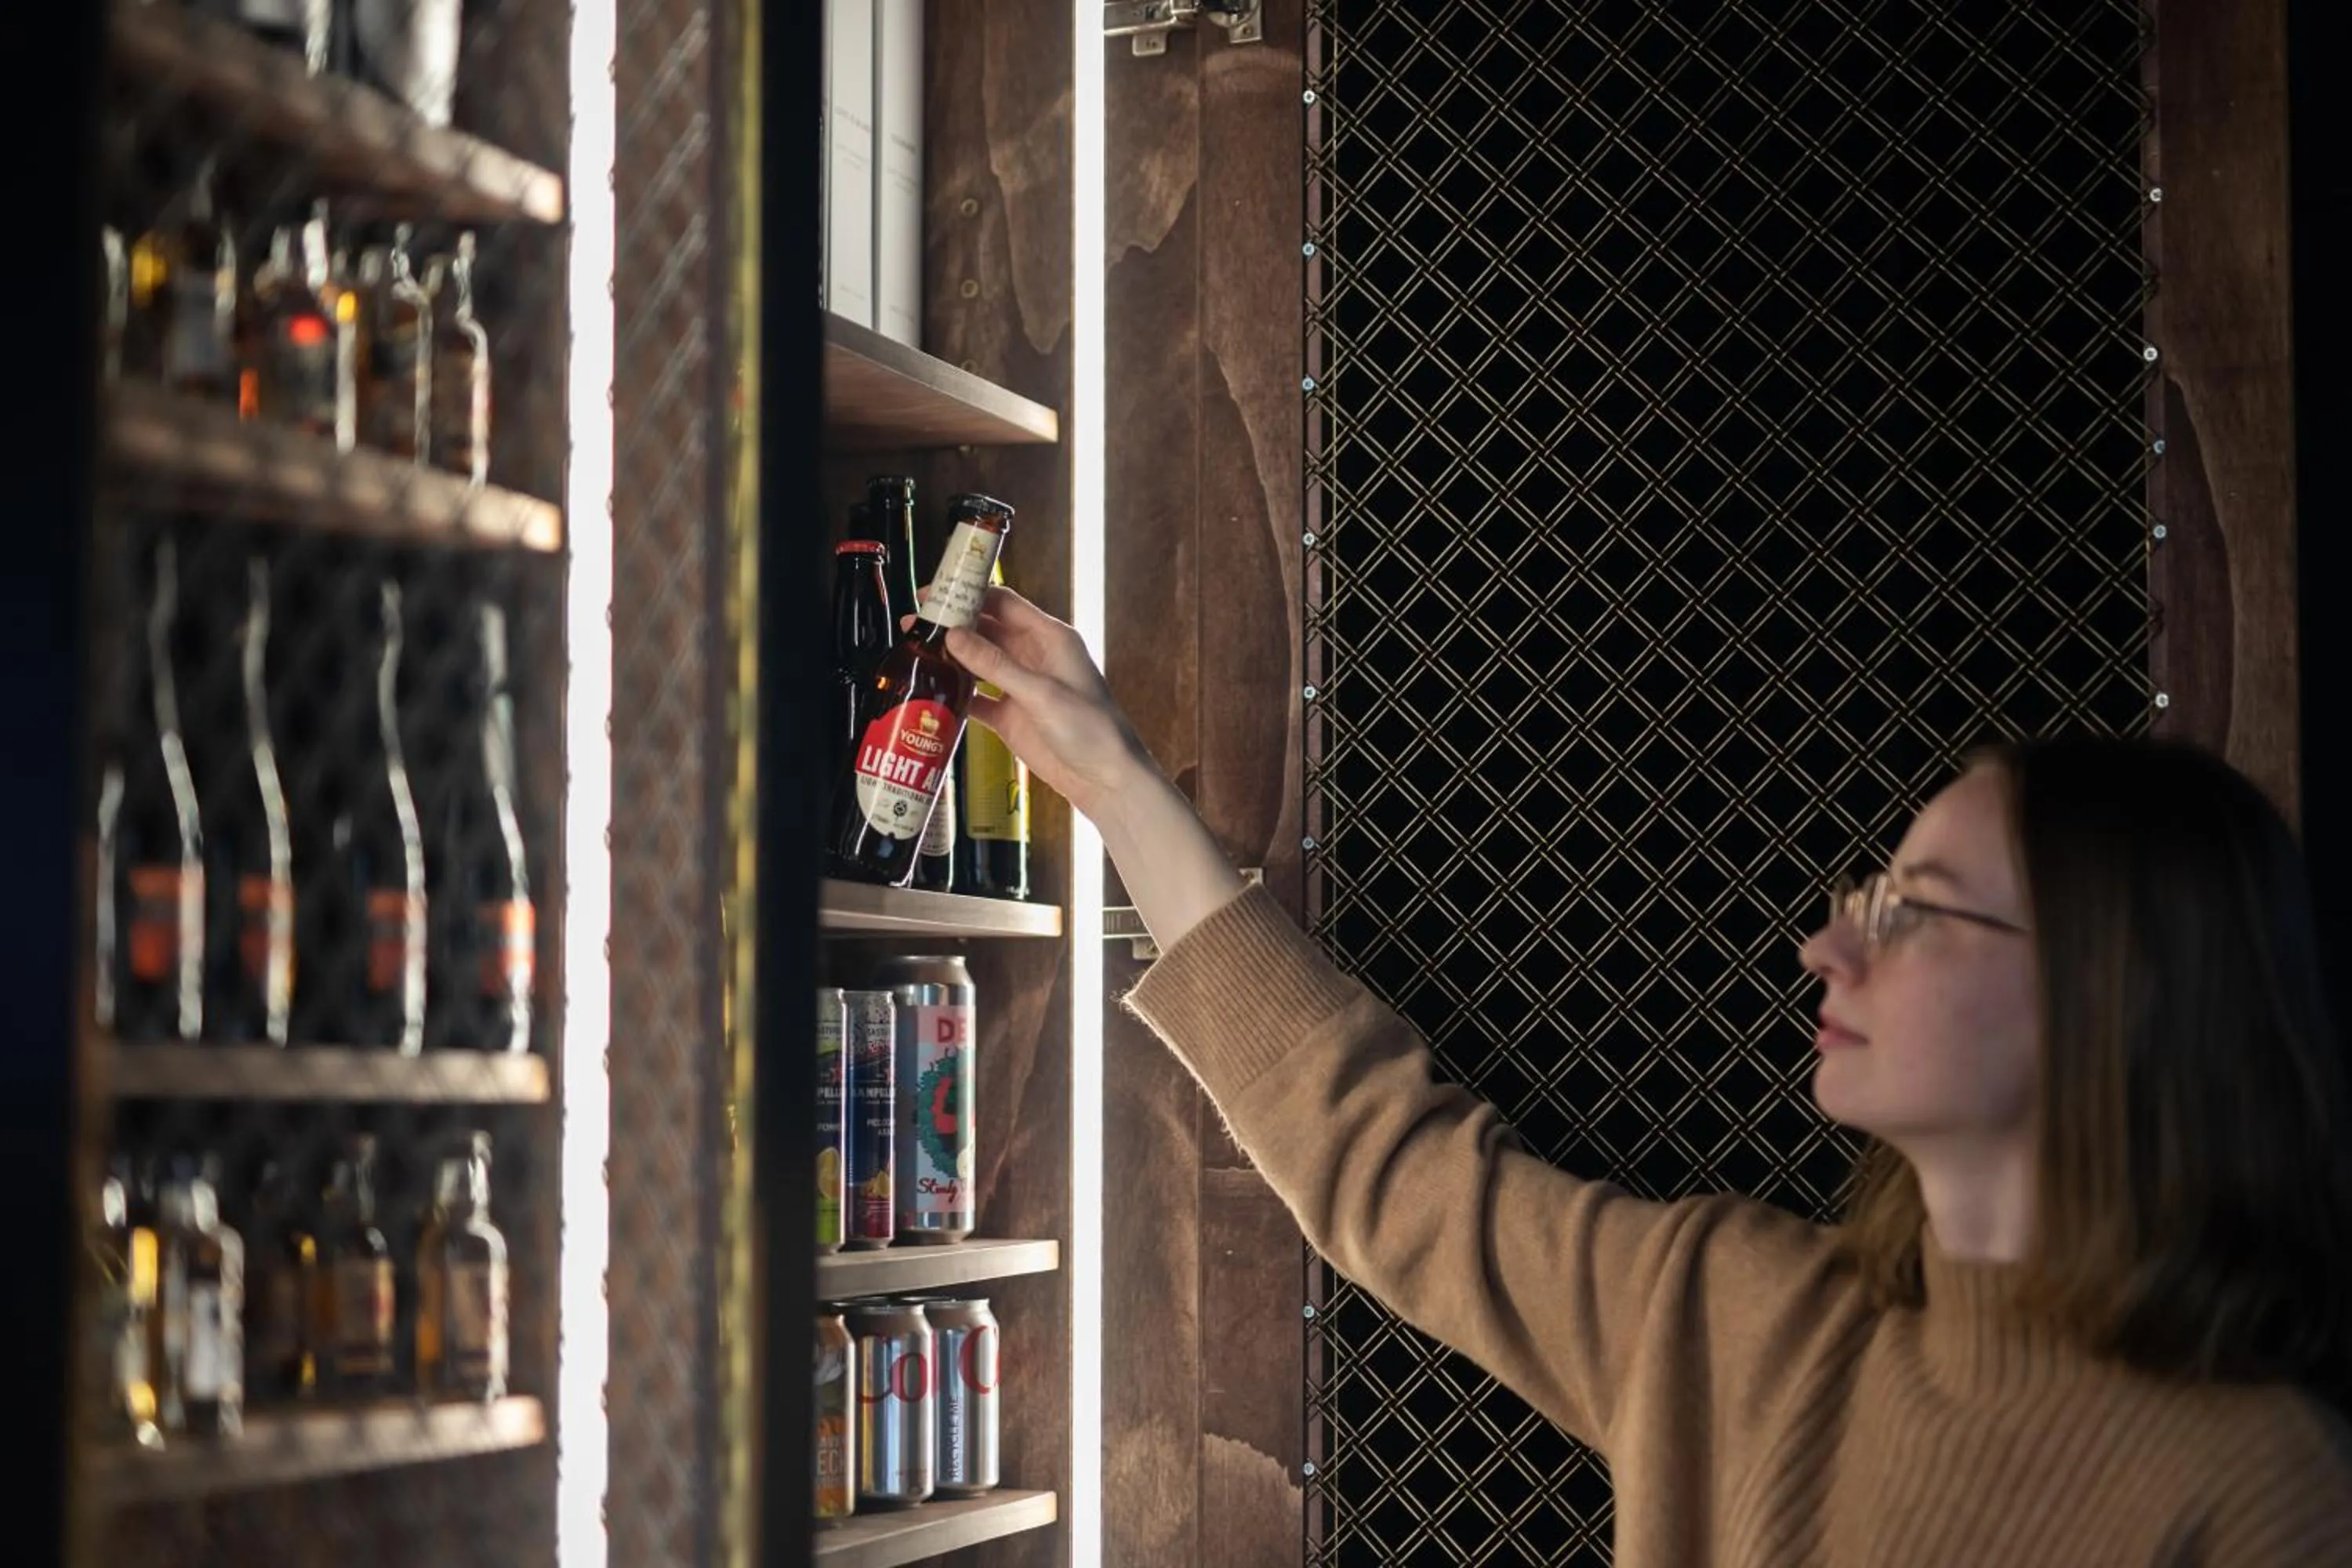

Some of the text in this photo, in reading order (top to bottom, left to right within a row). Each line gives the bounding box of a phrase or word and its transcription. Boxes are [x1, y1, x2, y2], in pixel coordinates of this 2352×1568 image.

[861, 745, 941, 792] LIGHT AL
[937, 1017, 967, 1044] DE
